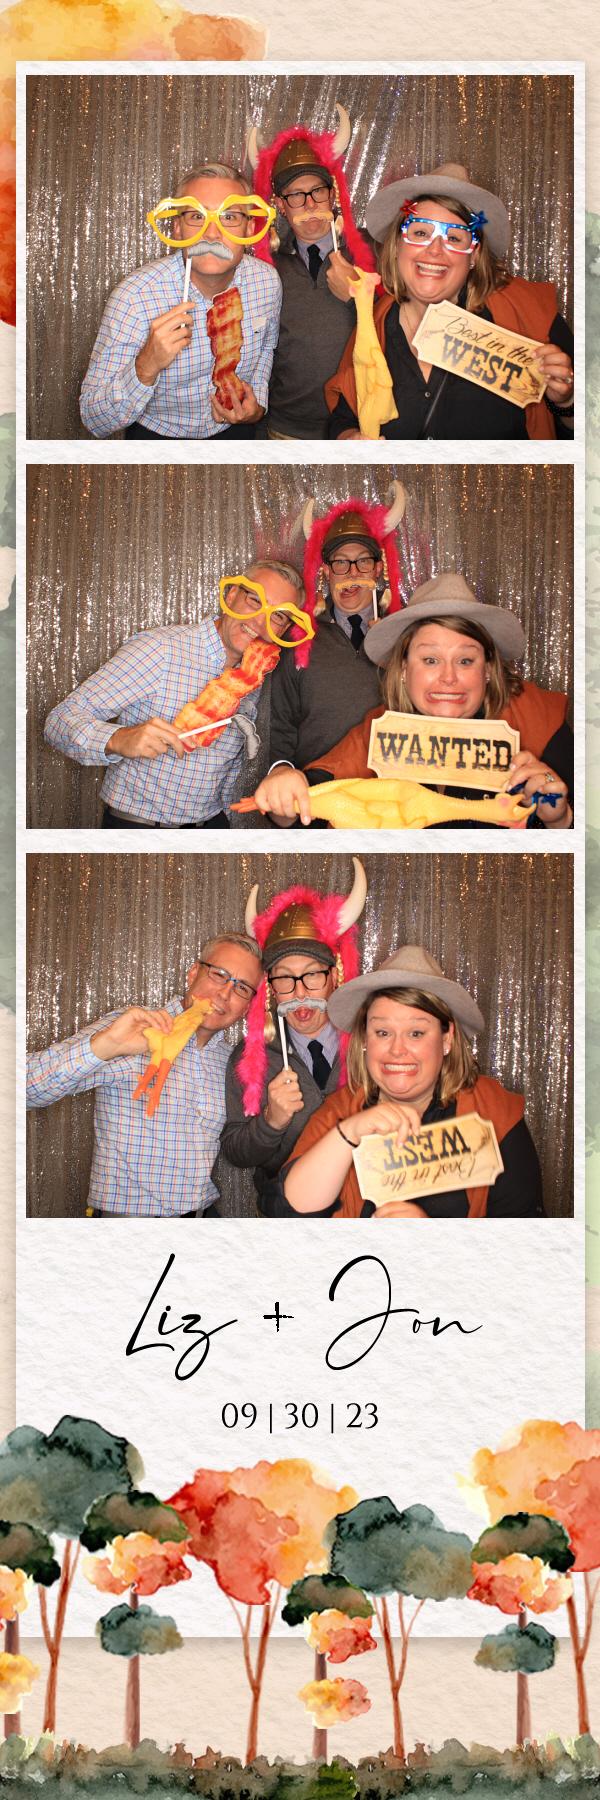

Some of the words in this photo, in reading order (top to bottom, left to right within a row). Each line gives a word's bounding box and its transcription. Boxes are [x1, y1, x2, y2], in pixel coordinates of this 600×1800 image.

[436, 310, 487, 344] Best
[486, 332, 506, 353] in
[507, 345, 534, 366] the
[440, 333, 524, 393] WEST
[377, 732, 512, 772] WANTED
[383, 1125, 472, 1172] WEST
[381, 1171, 407, 1192] the
[413, 1166, 430, 1184] in
